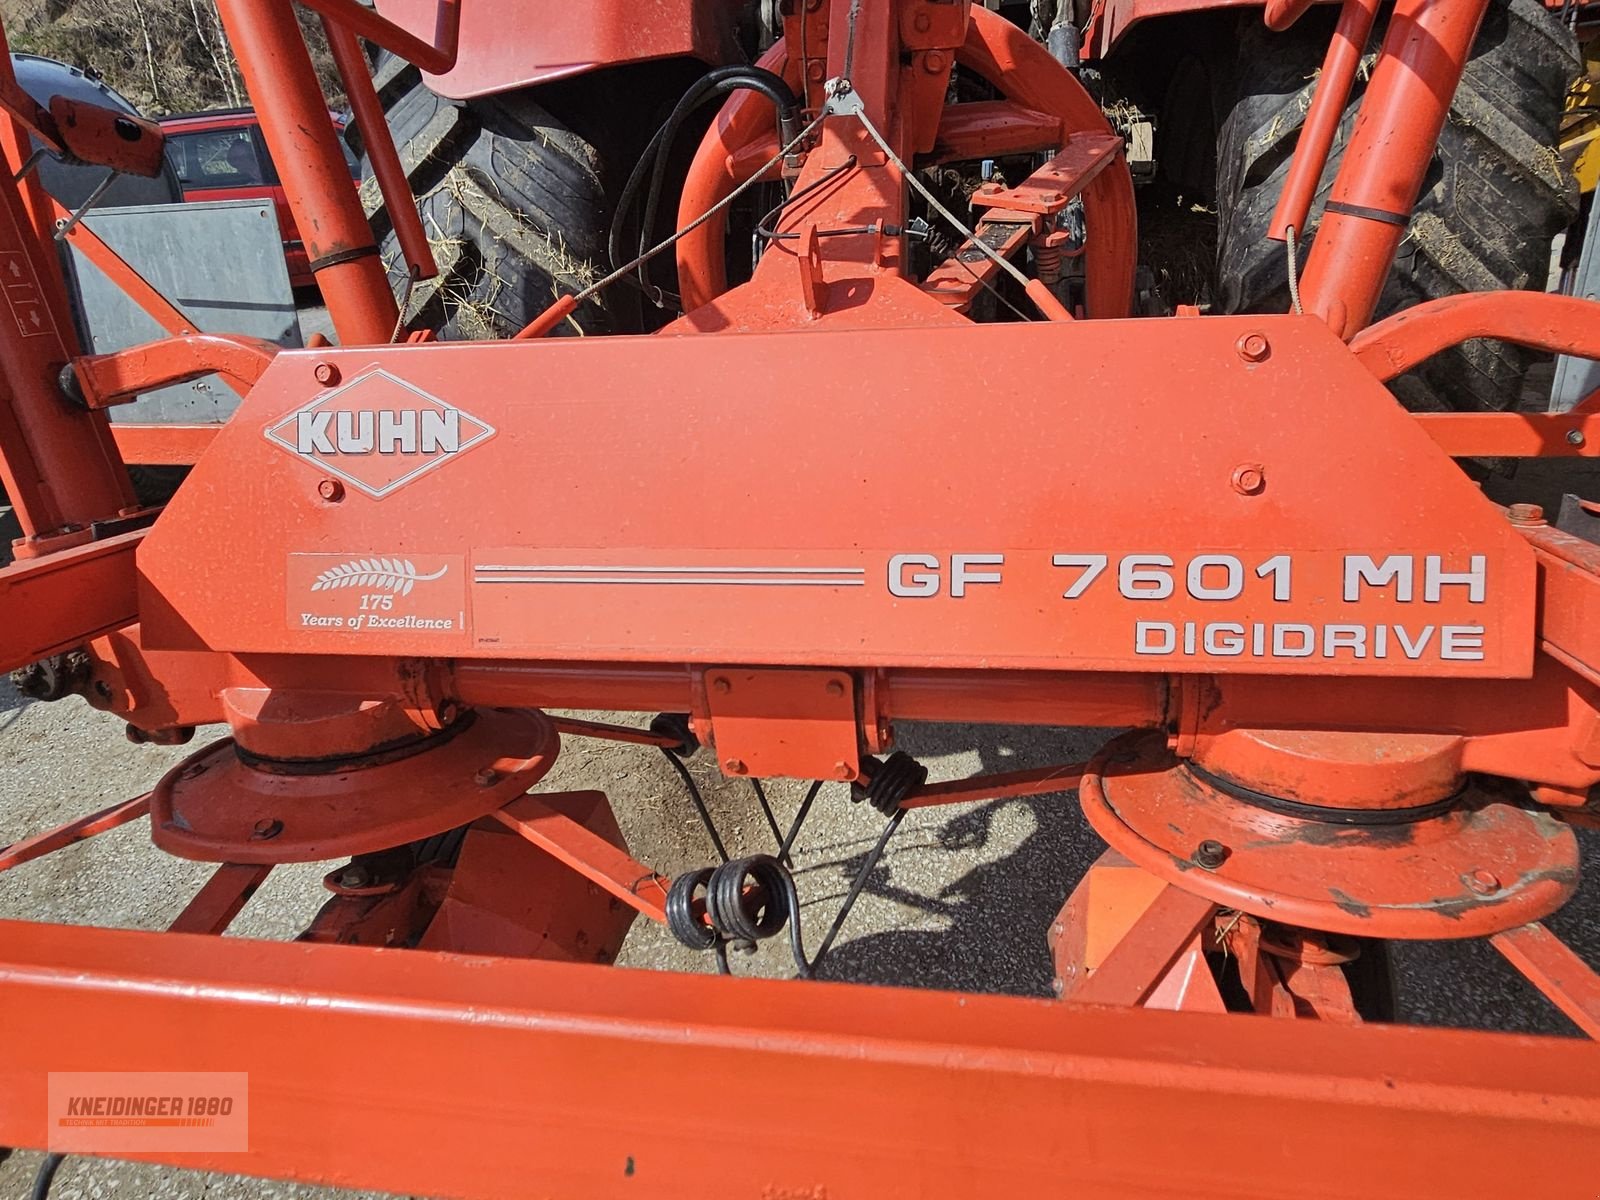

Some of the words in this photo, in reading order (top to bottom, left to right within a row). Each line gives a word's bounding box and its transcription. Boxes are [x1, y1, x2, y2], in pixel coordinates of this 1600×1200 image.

[297, 409, 460, 455] KUHN
[888, 553, 1004, 598] GF
[1052, 553, 1292, 601] 7601
[1343, 554, 1486, 603] MH
[301, 613, 343, 627] Years
[347, 614, 366, 630] of
[367, 615, 452, 629] Excellence
[359, 594, 395, 611] 175
[1135, 621, 1485, 660] DIGIDRIVE
